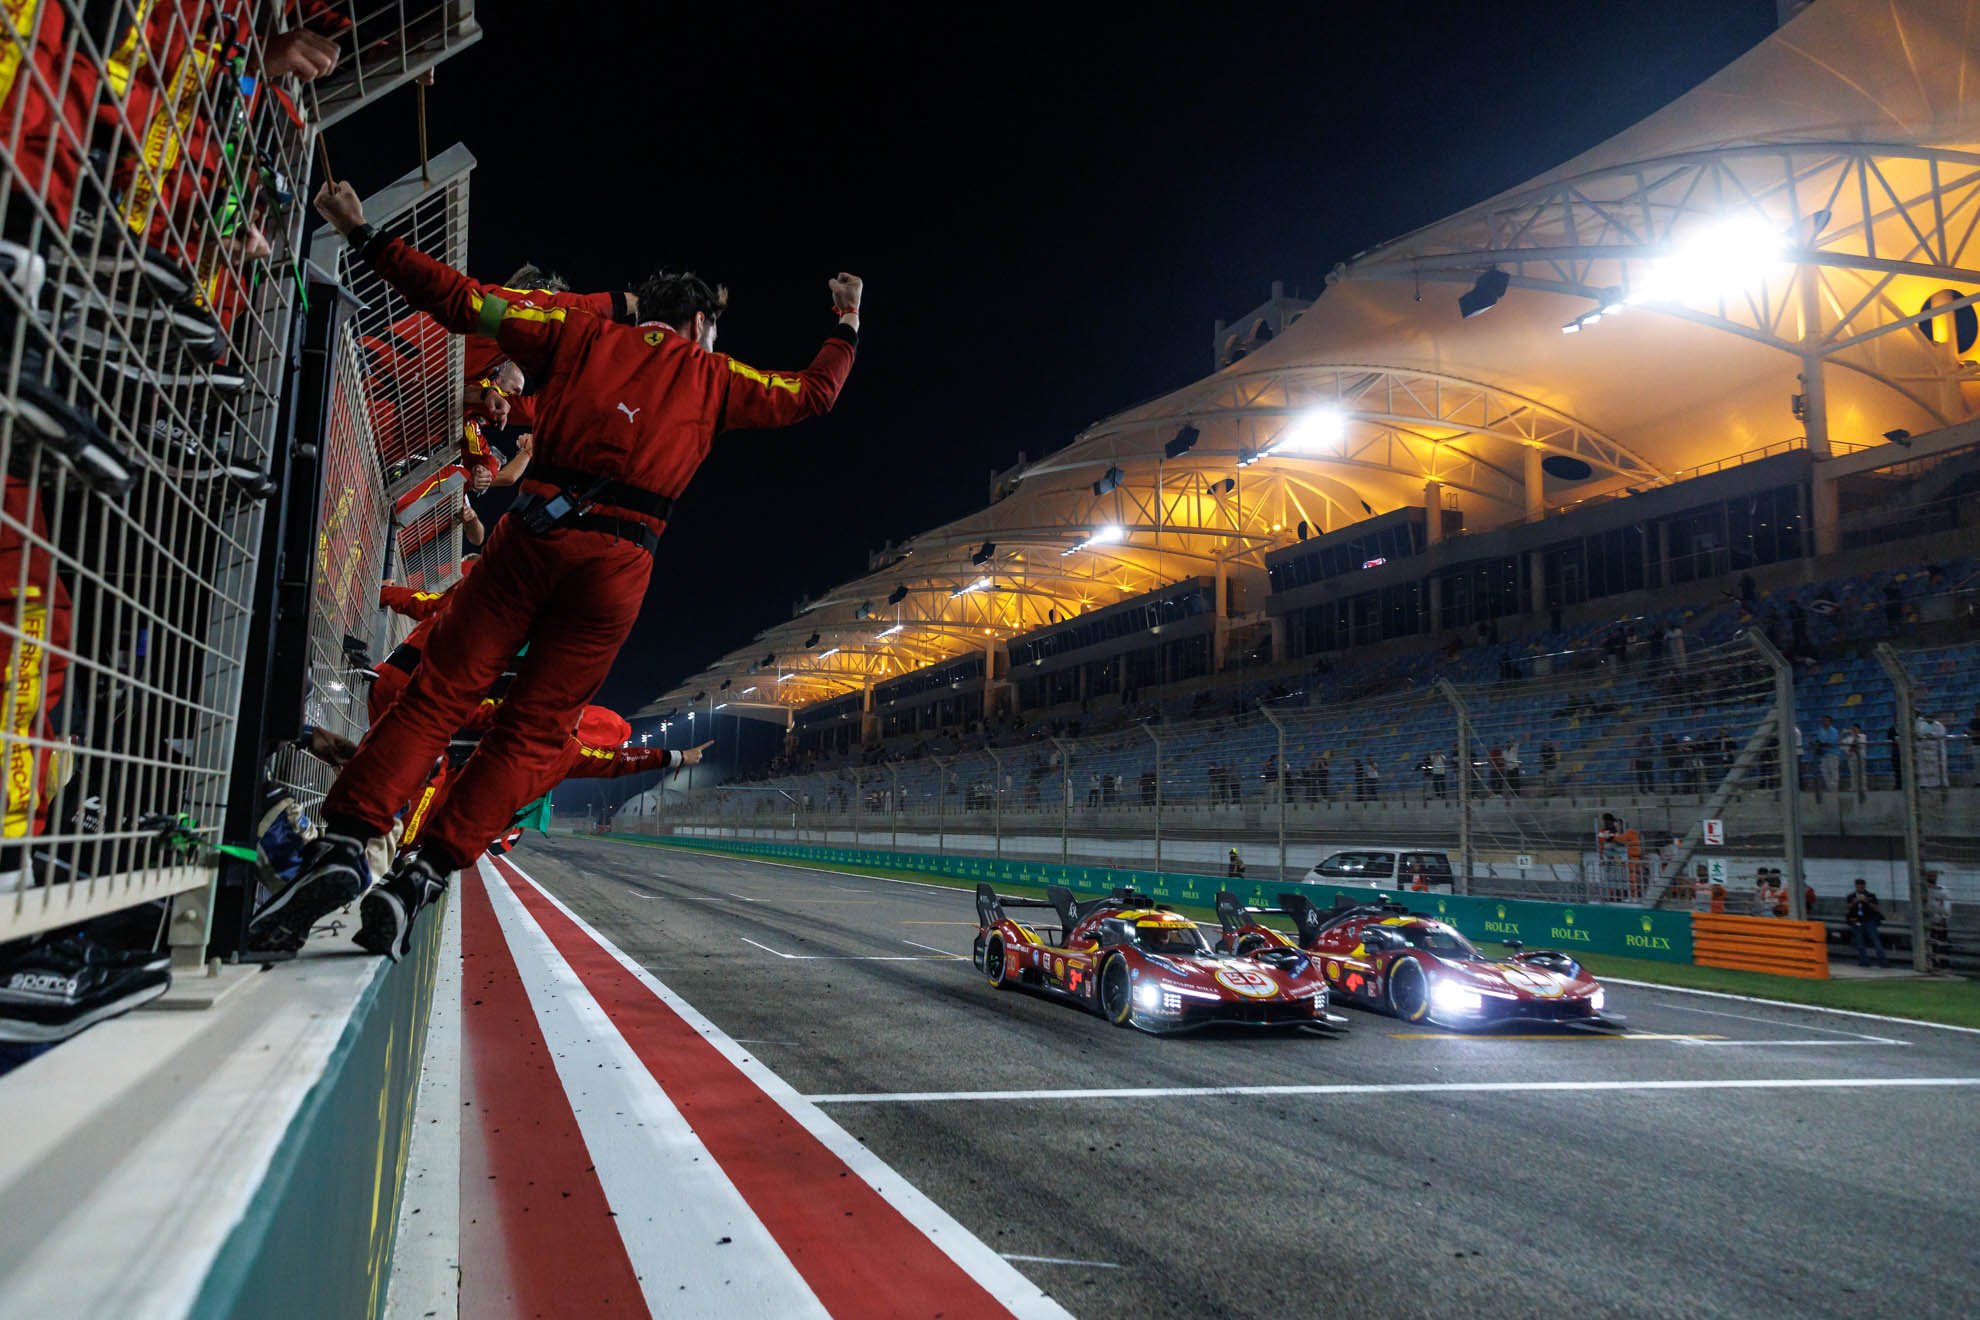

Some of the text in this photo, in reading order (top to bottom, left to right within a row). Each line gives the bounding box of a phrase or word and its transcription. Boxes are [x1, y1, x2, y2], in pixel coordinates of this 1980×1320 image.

[1248, 898, 1269, 907] ROLEX
[1484, 921, 1520, 935] ROLEX
[1551, 927, 1590, 942] ROLEX
[1626, 933, 1671, 950] ROLEX
[10, 973, 78, 994] sparco
